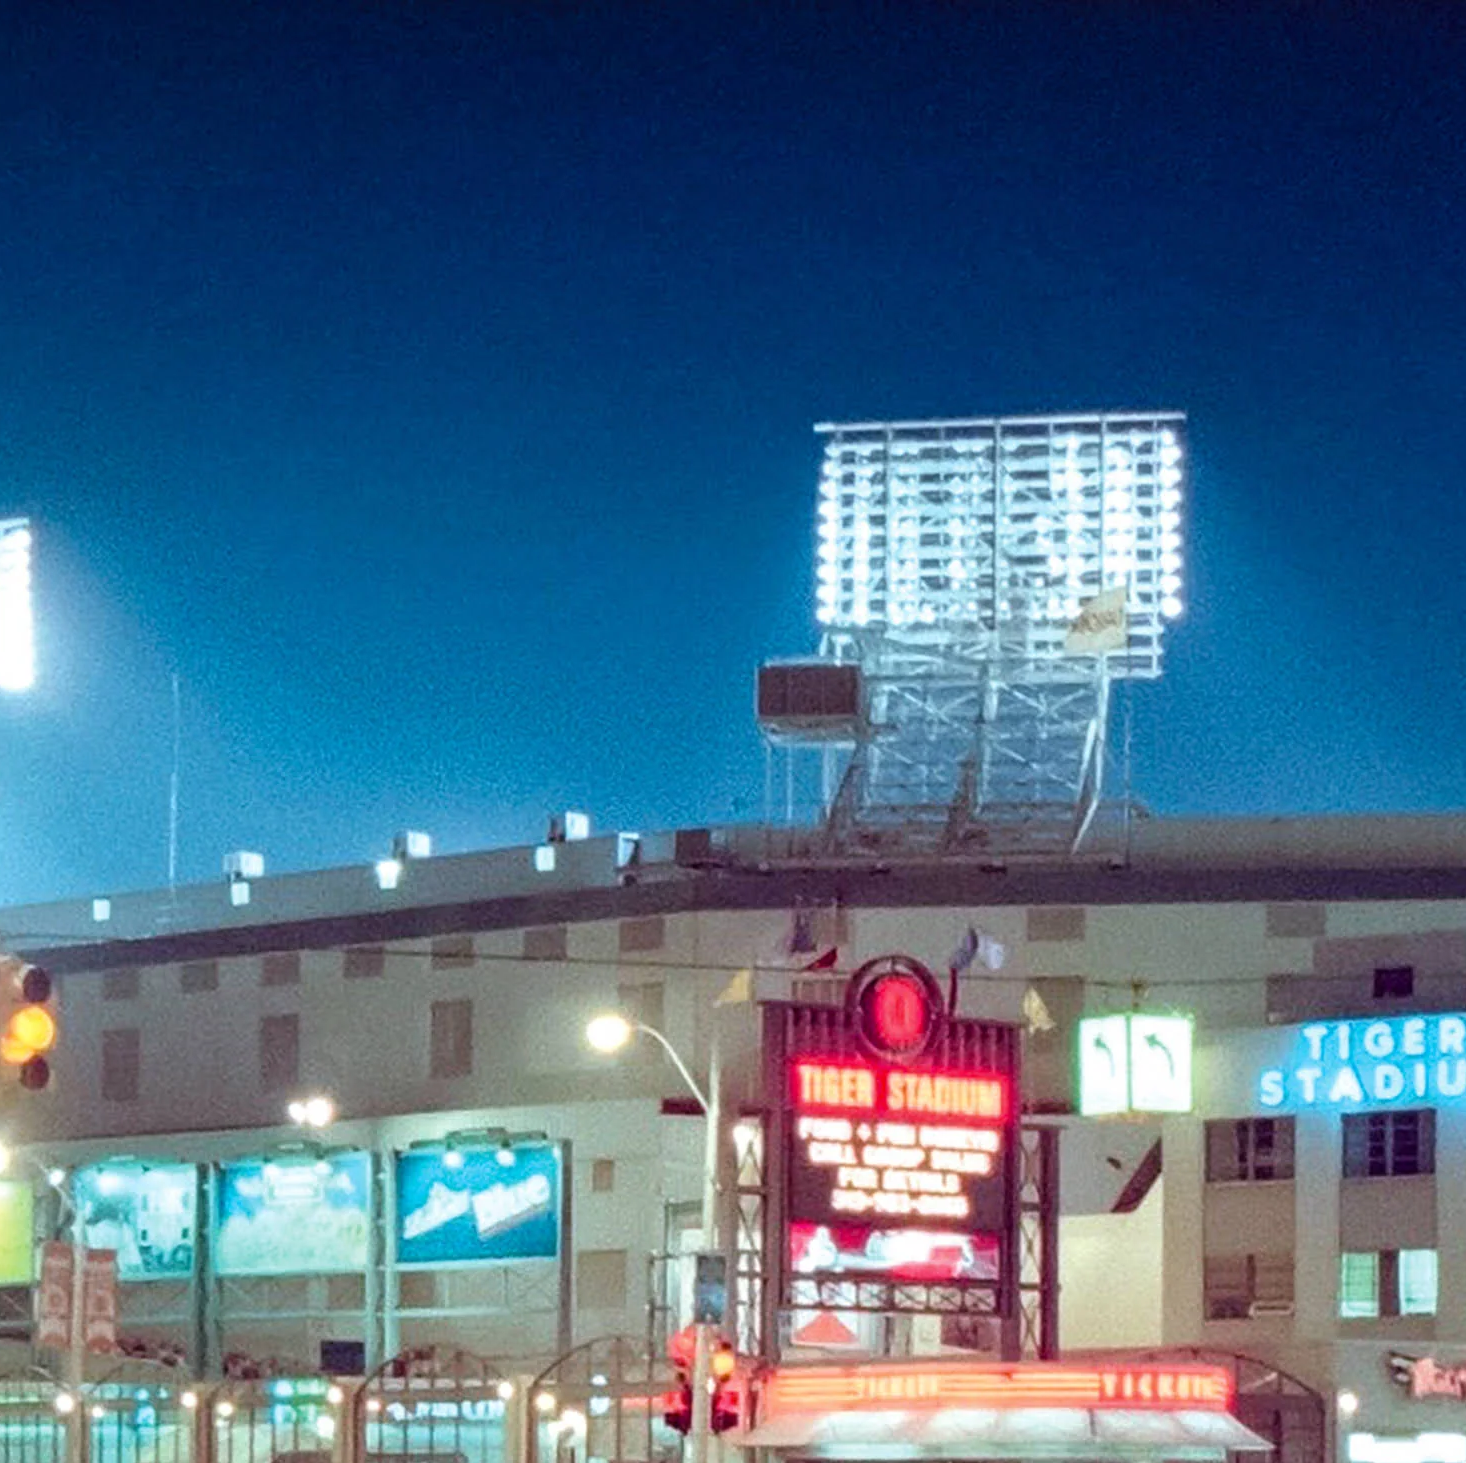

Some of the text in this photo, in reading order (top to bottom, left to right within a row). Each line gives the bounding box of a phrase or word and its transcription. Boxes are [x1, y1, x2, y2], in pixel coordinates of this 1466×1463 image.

[1303, 1017, 1466, 1061] TIGER
[798, 1064, 1002, 1118] TIGER STADIUM
[1102, 1373, 1225, 1399] TICKETS
